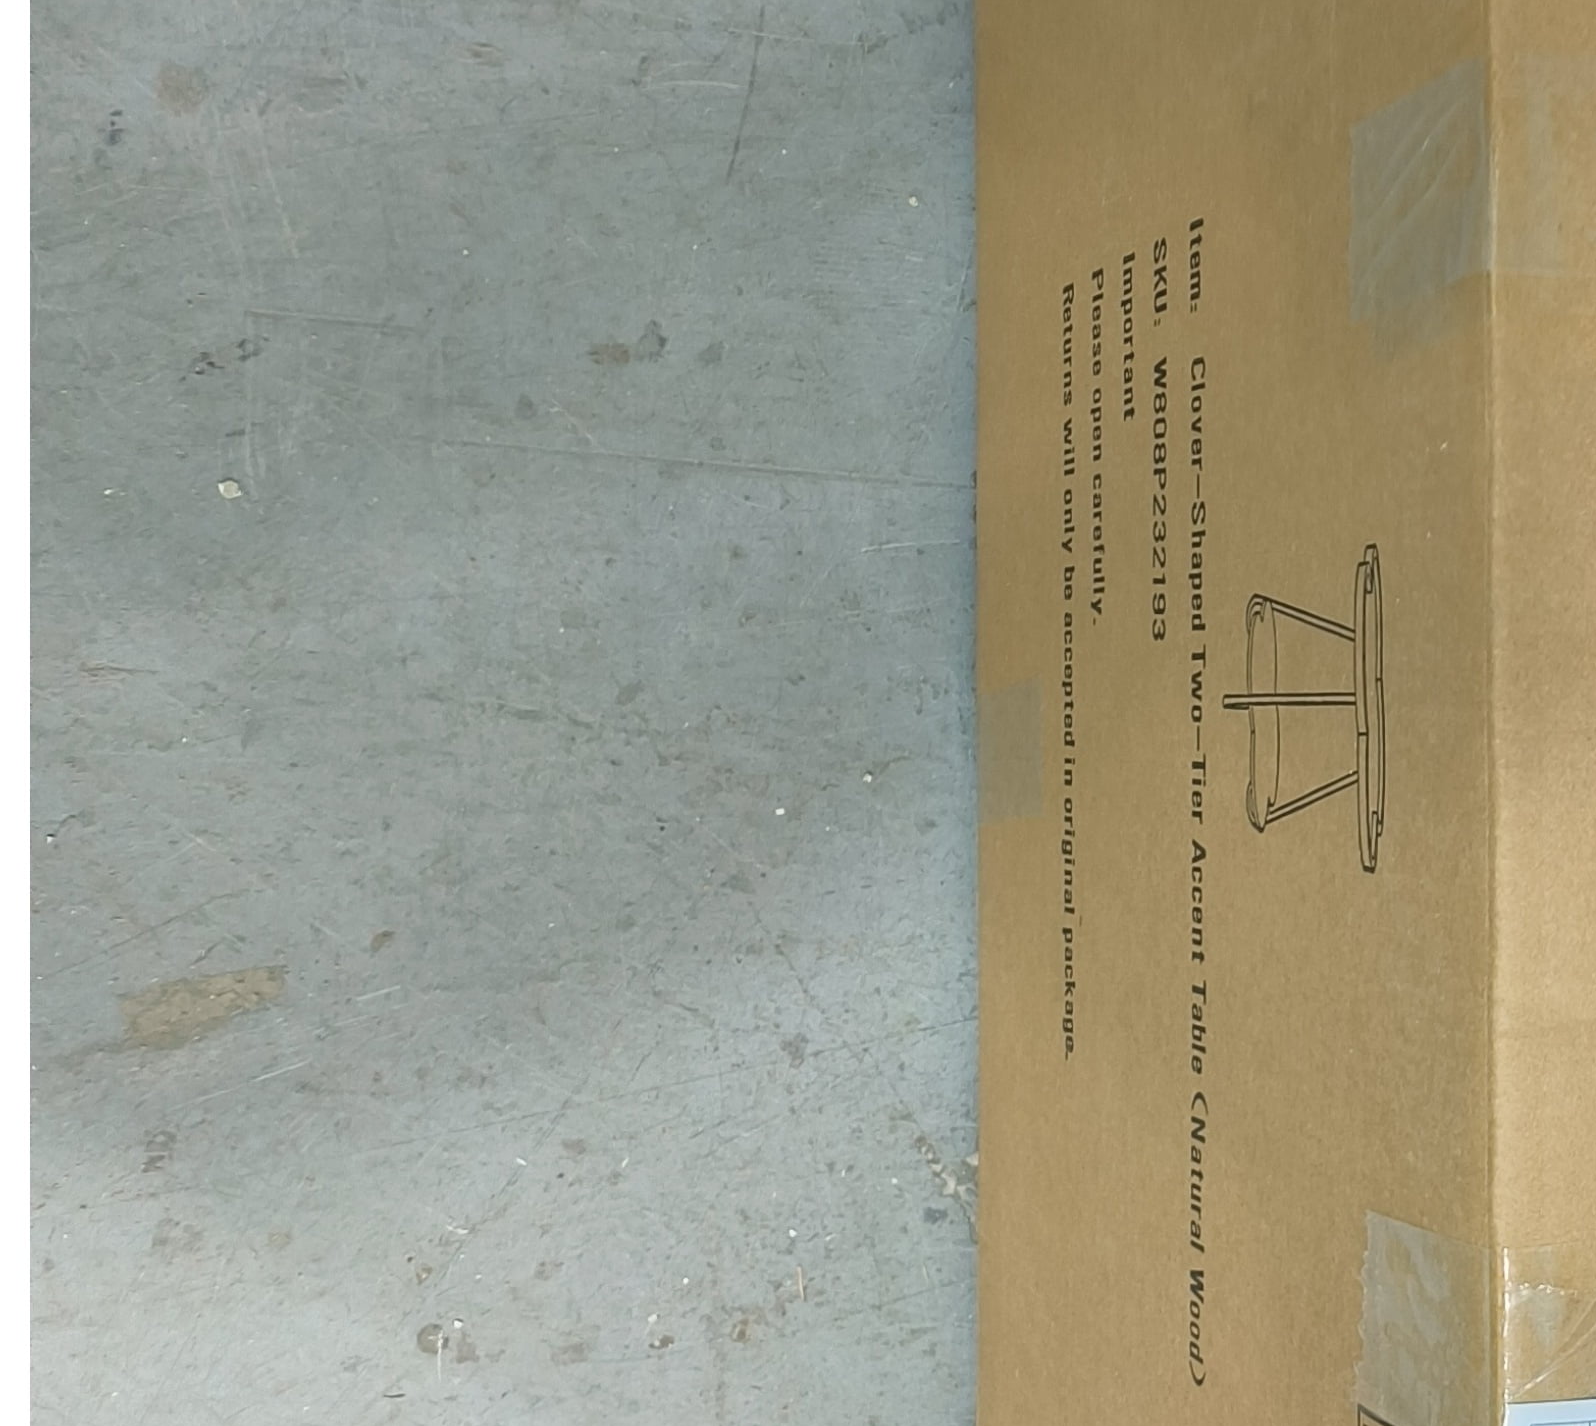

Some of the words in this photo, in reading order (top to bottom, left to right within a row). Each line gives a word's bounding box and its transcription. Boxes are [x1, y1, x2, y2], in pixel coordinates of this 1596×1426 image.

[1091, 267, 1104, 376] Please
[1153, 237, 1168, 327] SKU:
[1189, 218, 1204, 313] Item:
[1062, 282, 1075, 407] Returns
[1121, 252, 1136, 422] Important
[1063, 417, 1075, 477] will
[1090, 388, 1103, 462] open
[1061, 488, 1075, 553] only
[1090, 473, 1105, 626] carefully.
[1152, 357, 1167, 641] W808P232193
[1063, 565, 1076, 601] be
[1062, 611, 1076, 747] accepted
[1064, 757, 1076, 787] in
[1061, 797, 1076, 915] original
[1191, 839, 1206, 965] Accent
[1062, 926, 1077, 1061] package.
[1191, 980, 1207, 1074] Table
[1189, 1091, 1208, 1254] (Natural
[1188, 1268, 1206, 1387] Wood)
